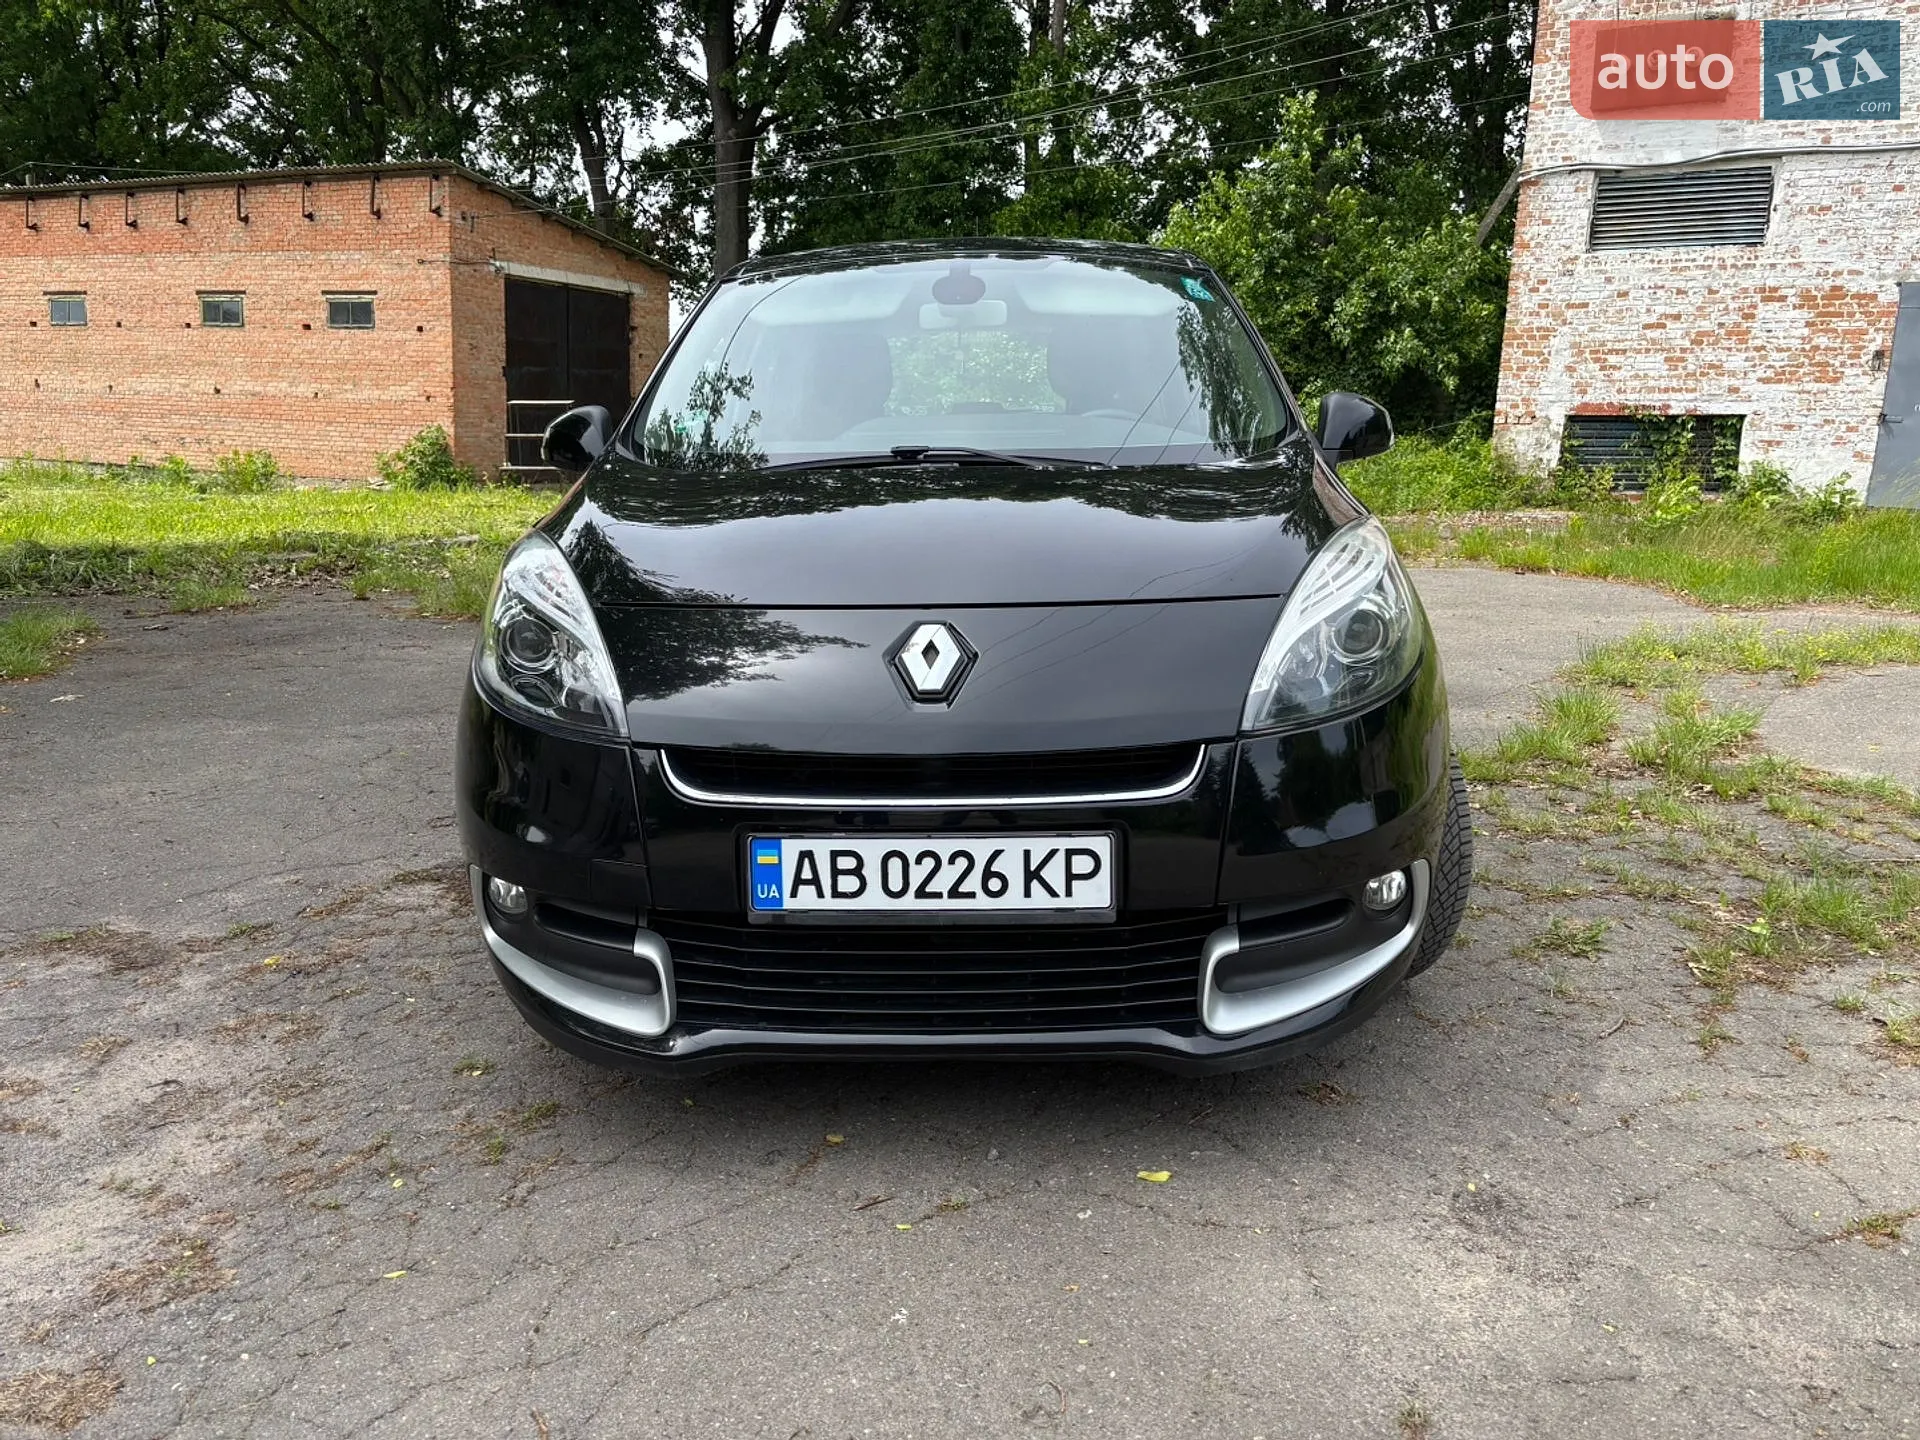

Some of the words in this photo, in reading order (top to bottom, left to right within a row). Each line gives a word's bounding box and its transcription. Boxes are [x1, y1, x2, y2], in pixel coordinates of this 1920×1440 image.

[789, 850, 867, 899] AB
[880, 849, 1009, 899] 0226
[1023, 848, 1102, 898] KP
[757, 883, 780, 899] UA
